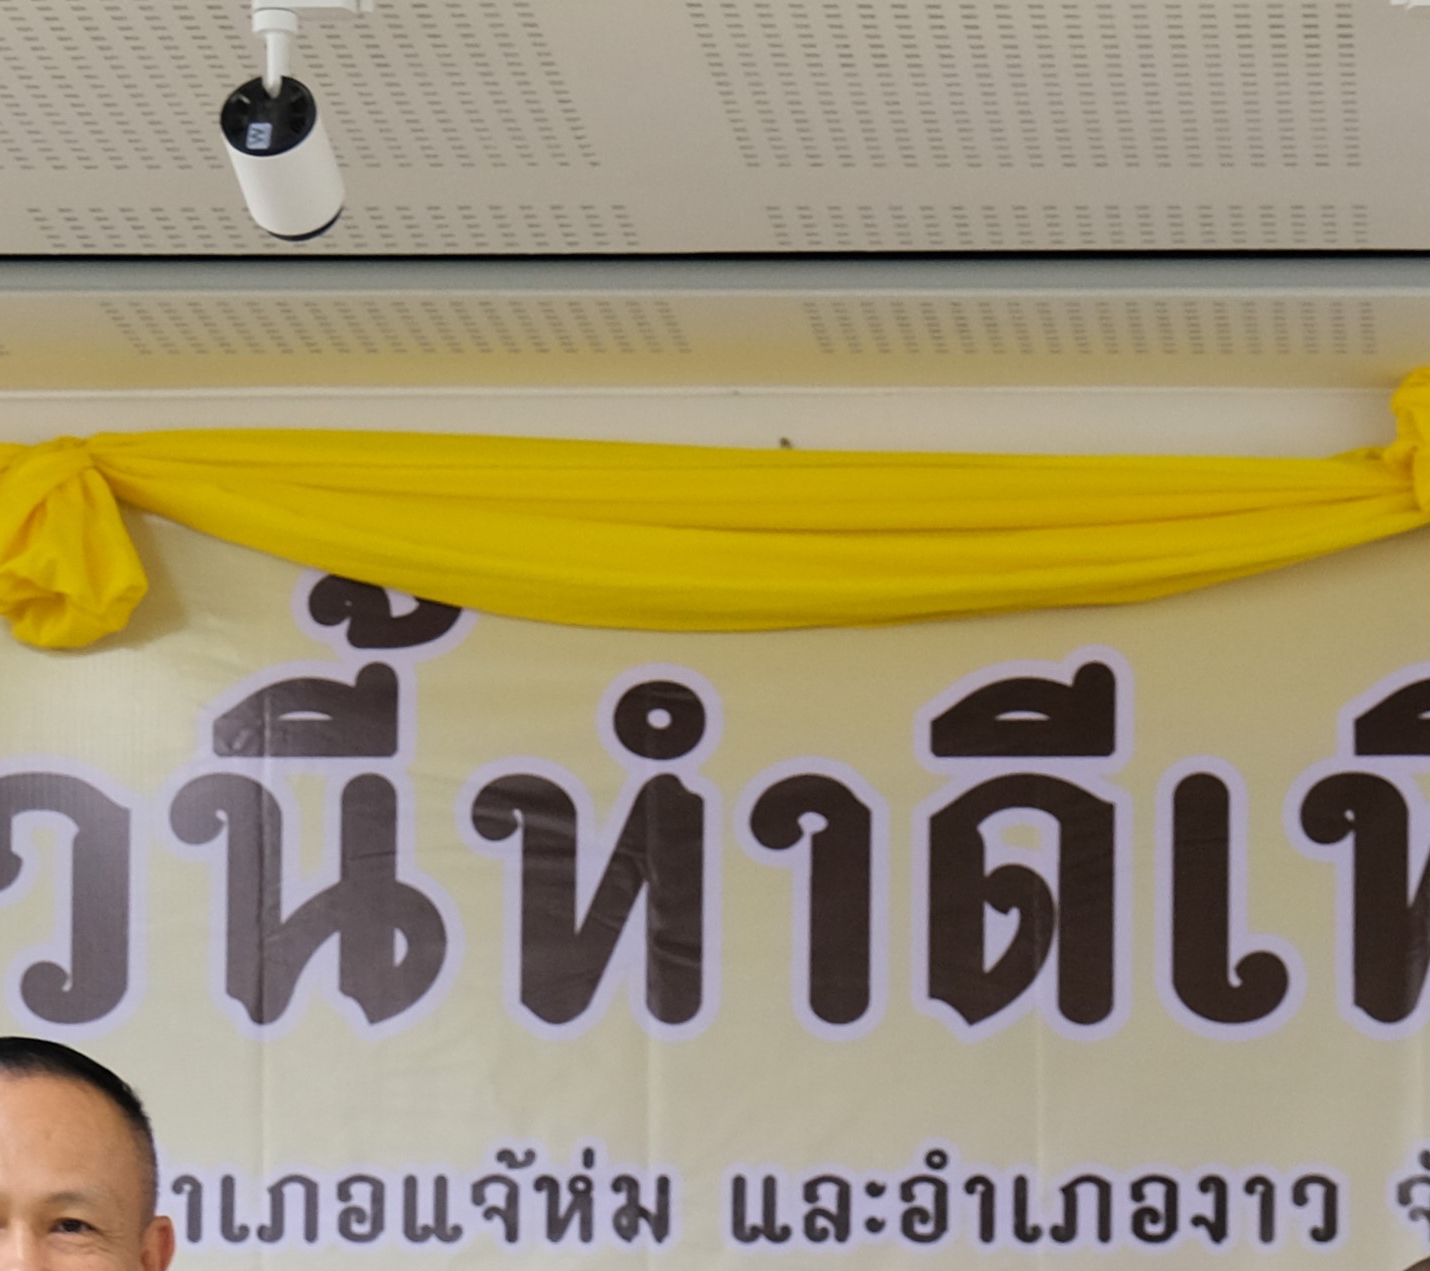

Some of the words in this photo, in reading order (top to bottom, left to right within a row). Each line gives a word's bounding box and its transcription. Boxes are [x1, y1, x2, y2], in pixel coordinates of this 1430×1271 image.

[729, 1149, 1338, 1247] และอำเภองาว
